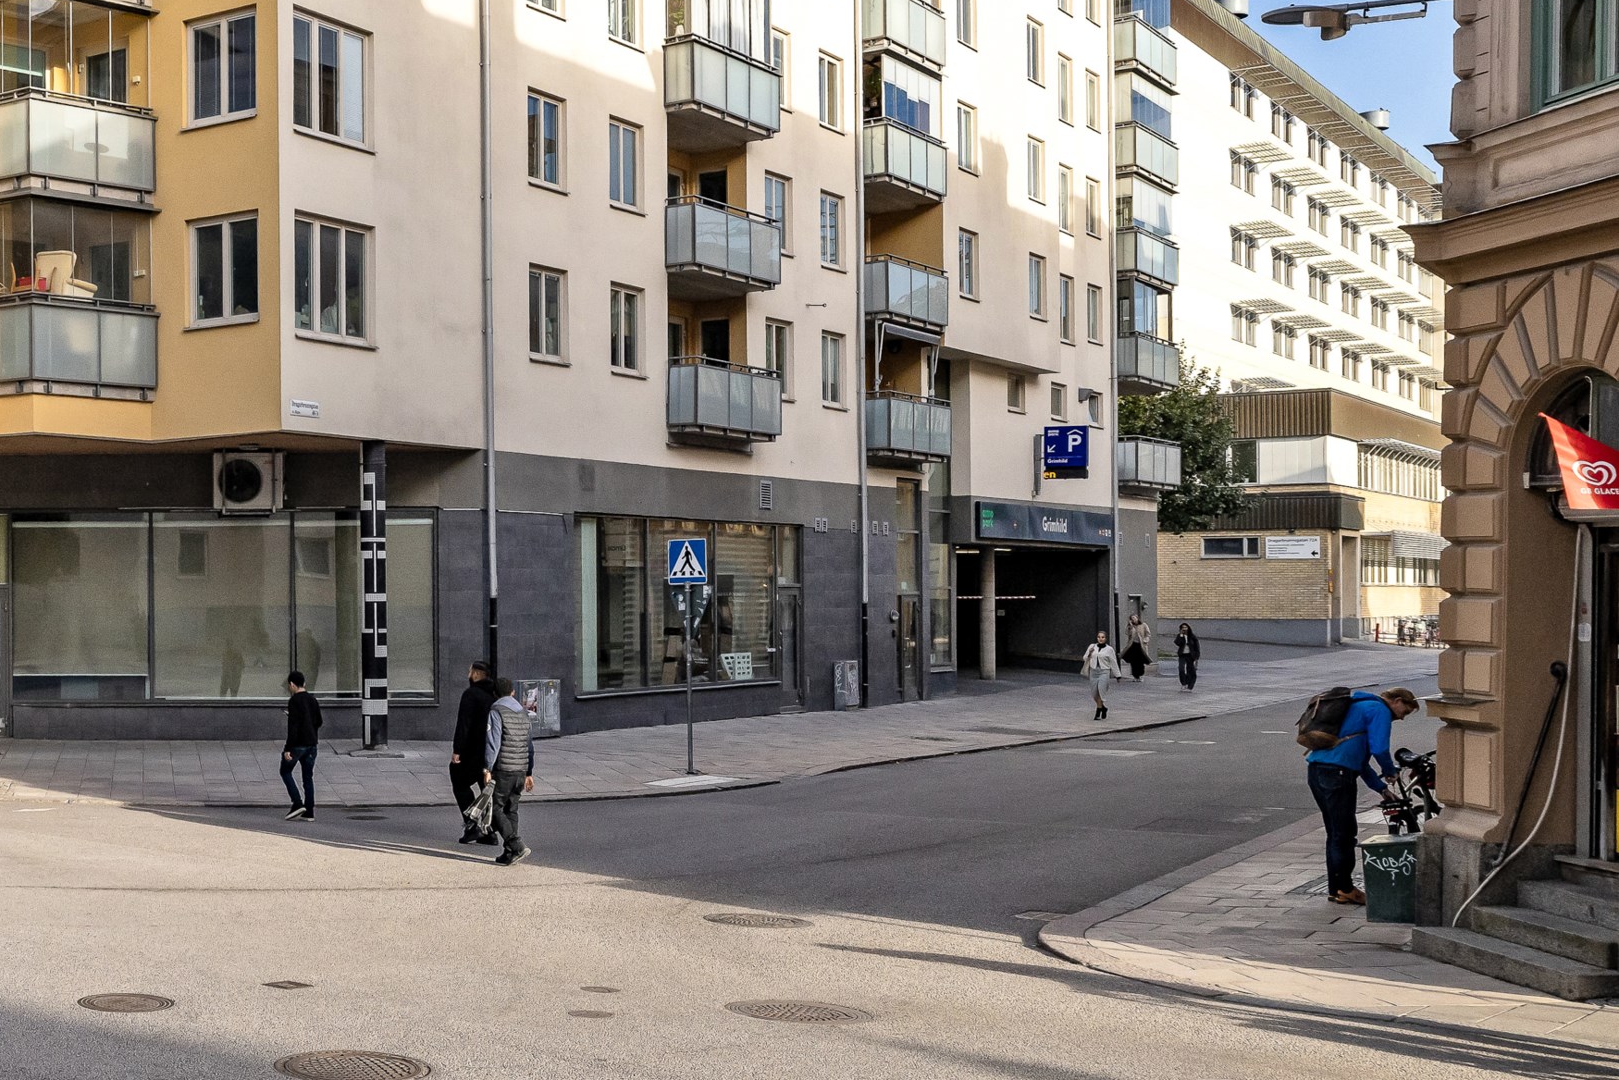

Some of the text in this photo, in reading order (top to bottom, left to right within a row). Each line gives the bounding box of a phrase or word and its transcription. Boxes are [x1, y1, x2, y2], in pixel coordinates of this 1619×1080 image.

[1068, 434, 1083, 453] P
[1580, 487, 1592, 495] GB
[1042, 516, 1068, 534] Grimhild
